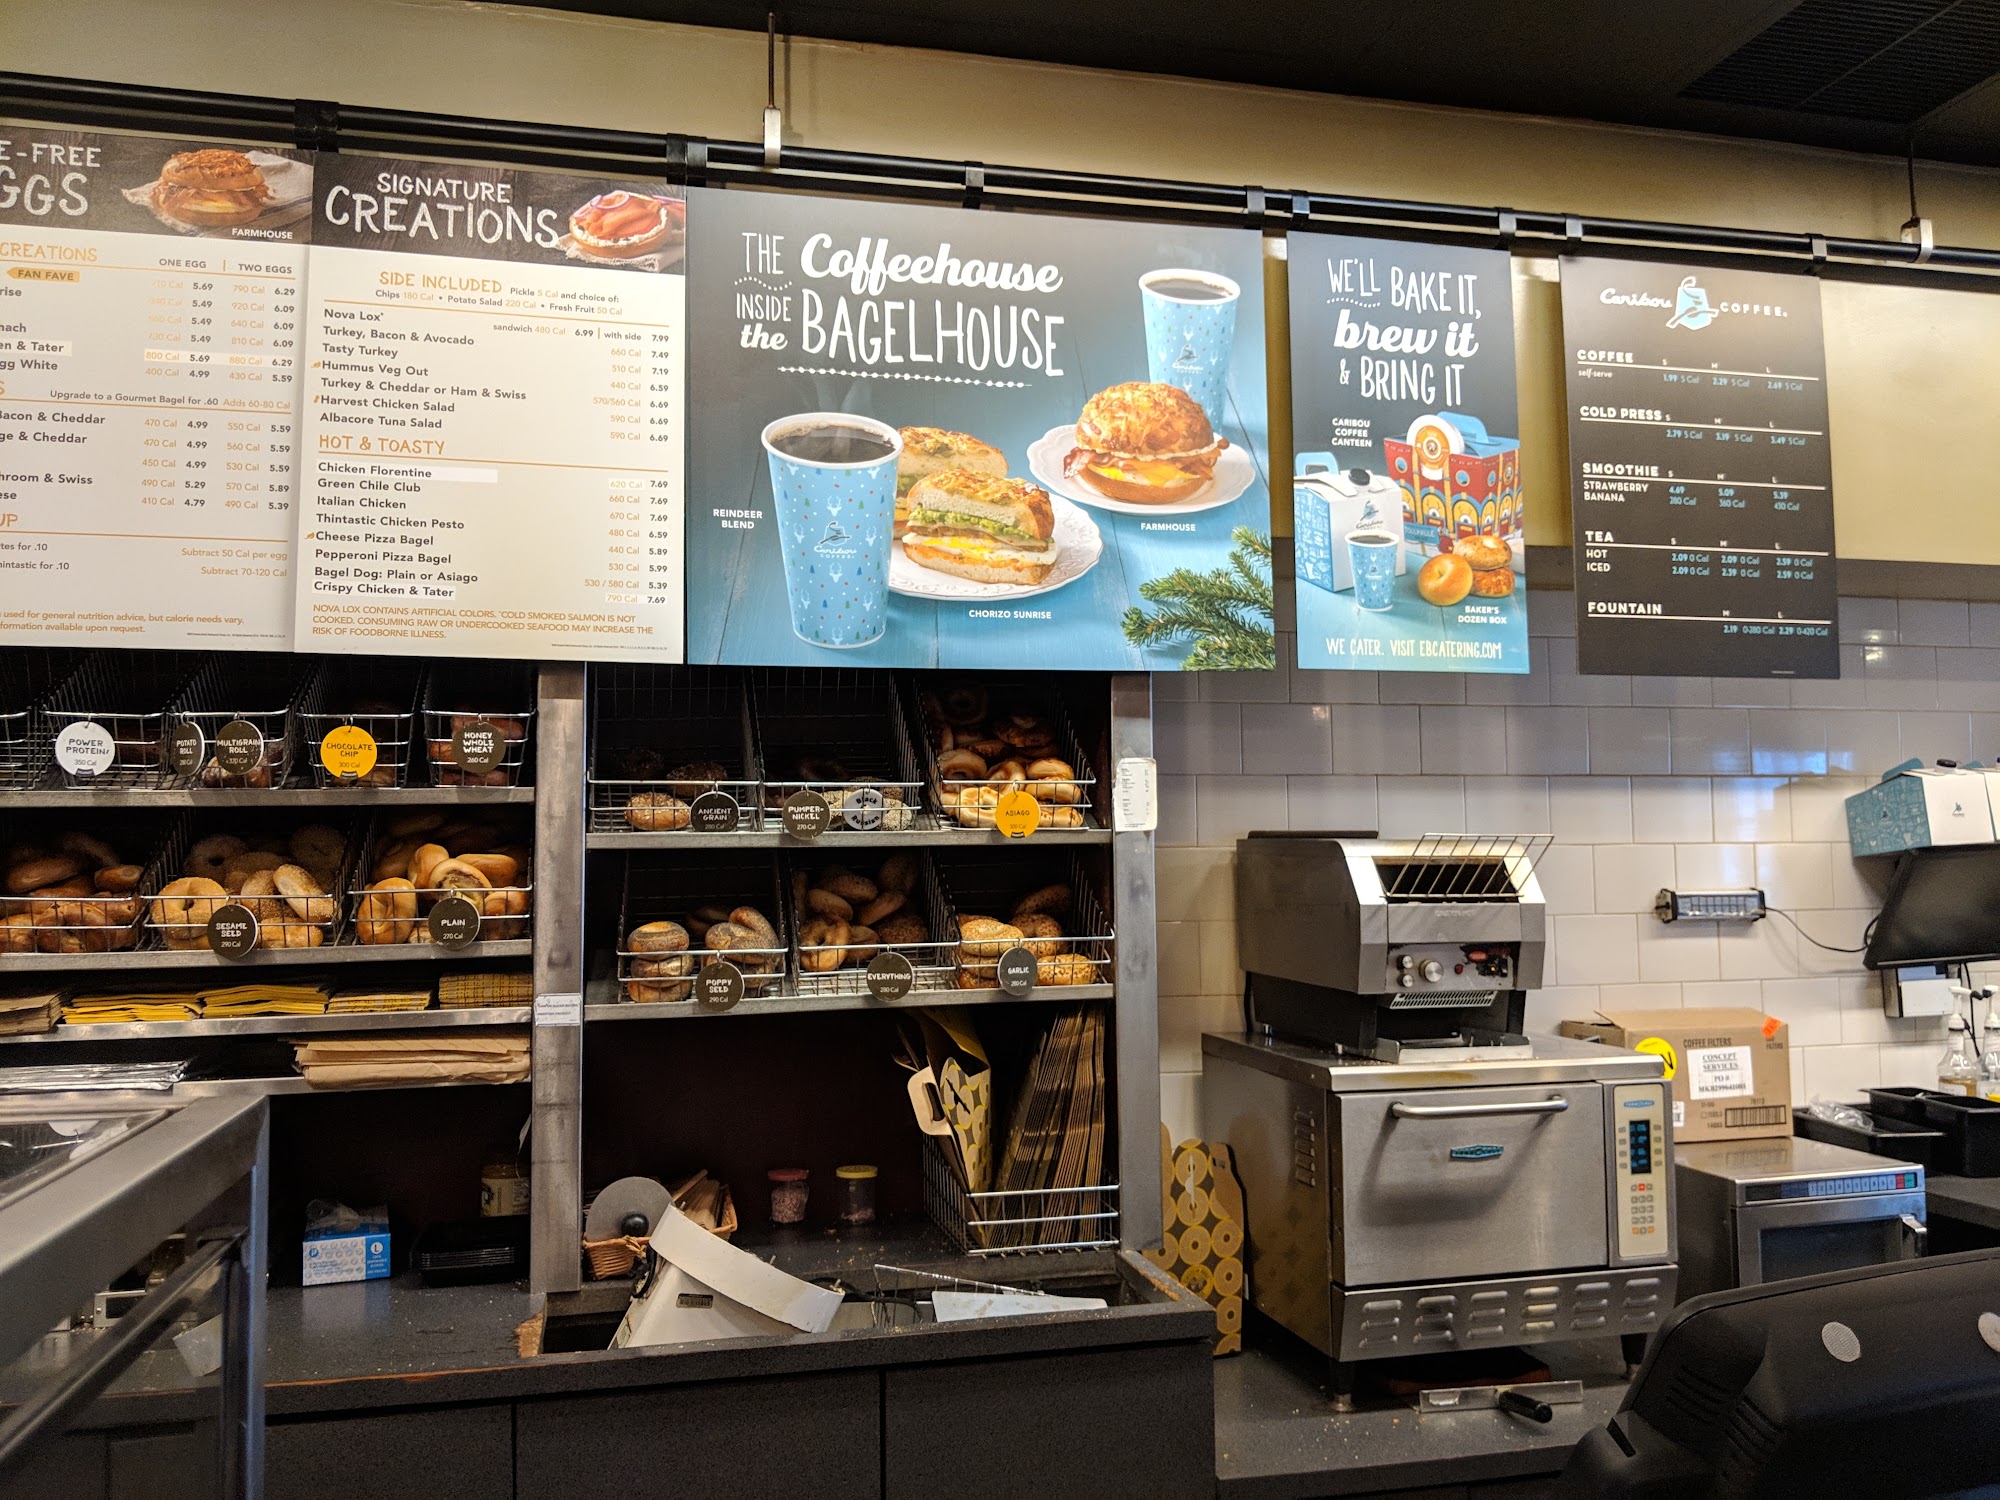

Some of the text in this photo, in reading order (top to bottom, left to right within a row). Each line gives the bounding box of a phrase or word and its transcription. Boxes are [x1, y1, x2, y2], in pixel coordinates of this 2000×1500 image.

[377, 172, 511, 203] SIGNATURE
[325, 185, 558, 248] CREATIONS
[232, 228, 293, 240] FARMHOUSE
[159, 258, 206, 269] ONE EGG
[238, 264, 292, 274] TWO EGGS
[742, 232, 1063, 296] THE Coffeehouse
[18, 270, 74, 280] FAN FAVE
[193, 282, 213, 291] 5.69
[380, 272, 501, 293] SIDE INCLUDED
[1327, 258, 1481, 319] WE'LL BAKE IT,
[274, 287, 295, 296] 6.29
[1600, 288, 1673, 309] Caribou
[736, 292, 792, 322] INSIDE
[324, 308, 355, 320] Nova
[323, 326, 474, 345] Turkey, Bacon & Avocado
[740, 288, 1064, 376] the BAGELHOUSE
[1333, 308, 1479, 358] brew it
[323, 343, 398, 359] Tasty Turkey
[1577, 350, 1633, 363] COFFEE
[322, 361, 428, 376] Hummus Veg Out
[1578, 368, 1613, 378] self-serve
[1339, 355, 1464, 406] & BRING IT
[321, 395, 455, 412] Harvest Chicken Salad
[38, 413, 47, 422] &
[52, 413, 105, 424] Cheddar
[1580, 406, 1662, 421] COLD PRESS
[320, 413, 442, 428] Albacore Tuna Salad
[1332, 418, 1370, 428] CARIBOU
[1335, 428, 1368, 437] COFFEE
[320, 434, 445, 455] HOT & TOASTY
[1332, 438, 1372, 448] CANTEEN
[318, 462, 432, 478] Chicken Florentine
[1583, 463, 1659, 477] SMOOTHIE
[318, 478, 420, 492] Green Chile Club
[1583, 481, 1648, 492] STRAWBERRY
[317, 496, 406, 509] Italian Chicken
[1584, 492, 1625, 502] BANANA
[713, 509, 762, 518] REINDEER
[317, 514, 465, 529] Thintastic Chicken Pesto
[722, 520, 754, 529] BLEND
[1141, 523, 1196, 531] FARMHOUSE
[316, 531, 434, 547] Cheese Pizza Bagel
[1585, 531, 1614, 542] TEA
[315, 549, 451, 566] Pepperoni Pizza Bagel
[1586, 549, 1608, 559] HOT
[1587, 563, 1611, 572] ICED
[315, 567, 349, 579] Bagel
[354, 568, 382, 580] Dog:
[387, 570, 415, 580] Plain
[437, 572, 478, 584] Asiago
[314, 581, 454, 597] Crispy Chicken & Tater
[968, 610, 1051, 619] CHORIZO SUNRISE
[1465, 605, 1499, 614] BAKER'S
[1588, 602, 1662, 615] FOUNTAIN
[1458, 615, 1507, 624] DOZEN BOX
[1326, 638, 1502, 660] WE CATER. VISIT EBCATERING.COM
[326, 742, 373, 751] CHOCOLATE
[1007, 966, 1030, 975] GARLIC
[706, 978, 732, 987] POPPY
[1683, 1038, 1732, 1048] COFFEE FILTERS
